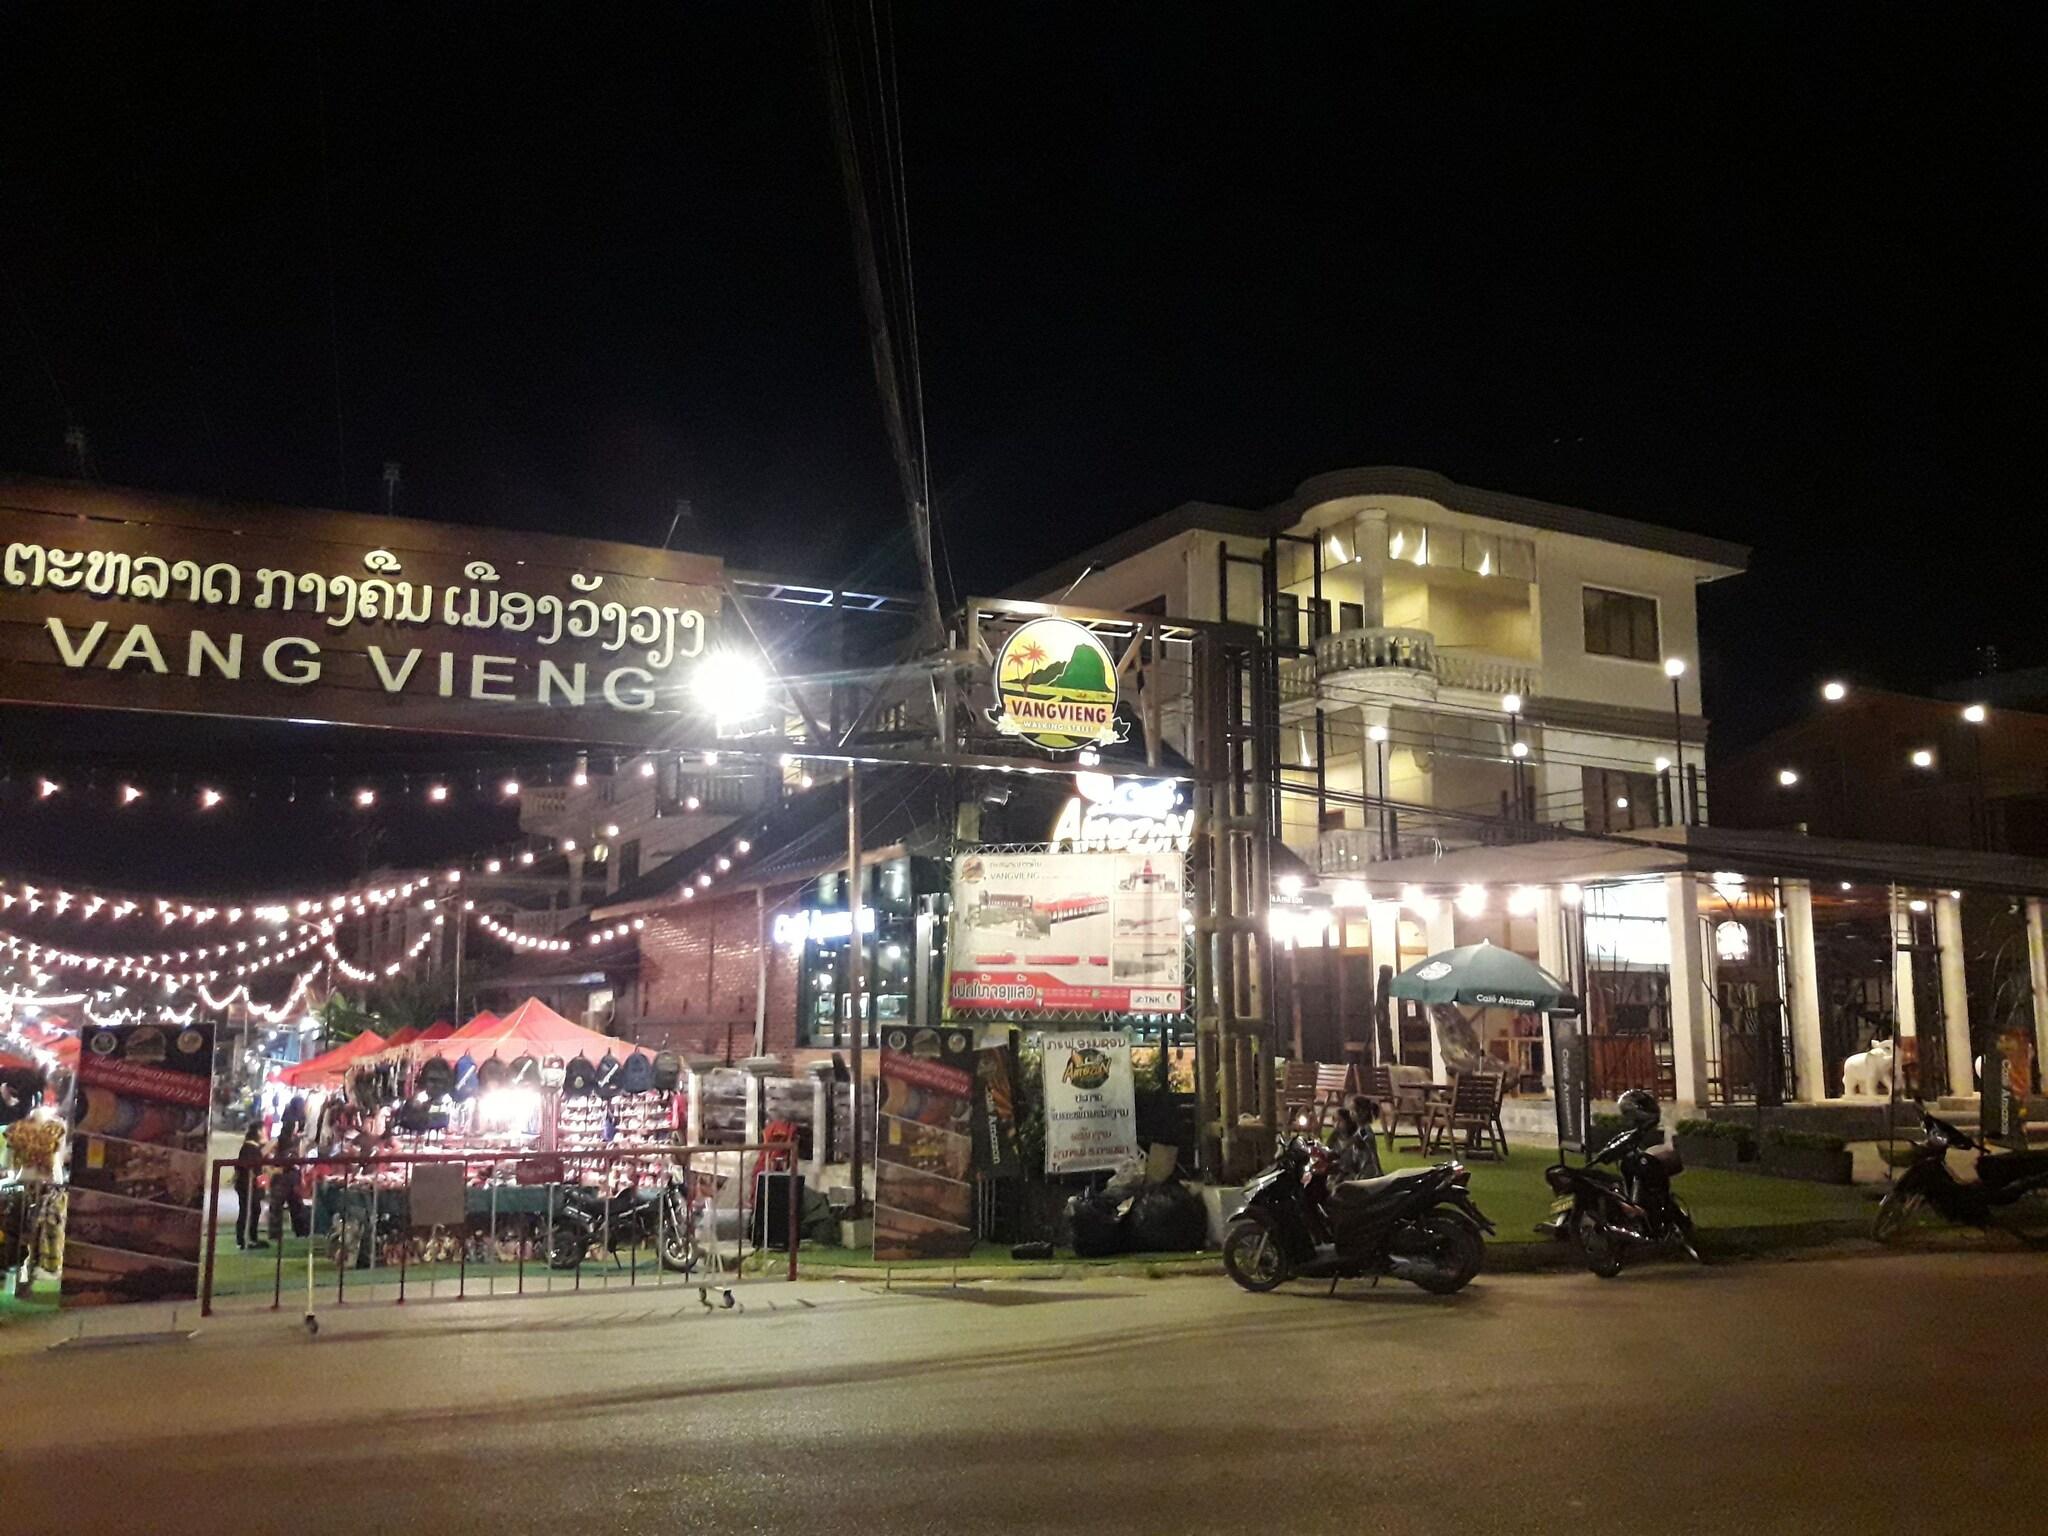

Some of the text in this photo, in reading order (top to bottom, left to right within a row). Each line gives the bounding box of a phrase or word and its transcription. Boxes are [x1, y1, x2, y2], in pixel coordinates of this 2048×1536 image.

[47, 616, 656, 711] VANG VIENG
[1011, 699, 1107, 724] VANGVIENG
[1023, 720, 1065, 731] WALKING
[1498, 995, 1535, 1007] Amazon
[988, 1114, 1001, 1164] Amazon
